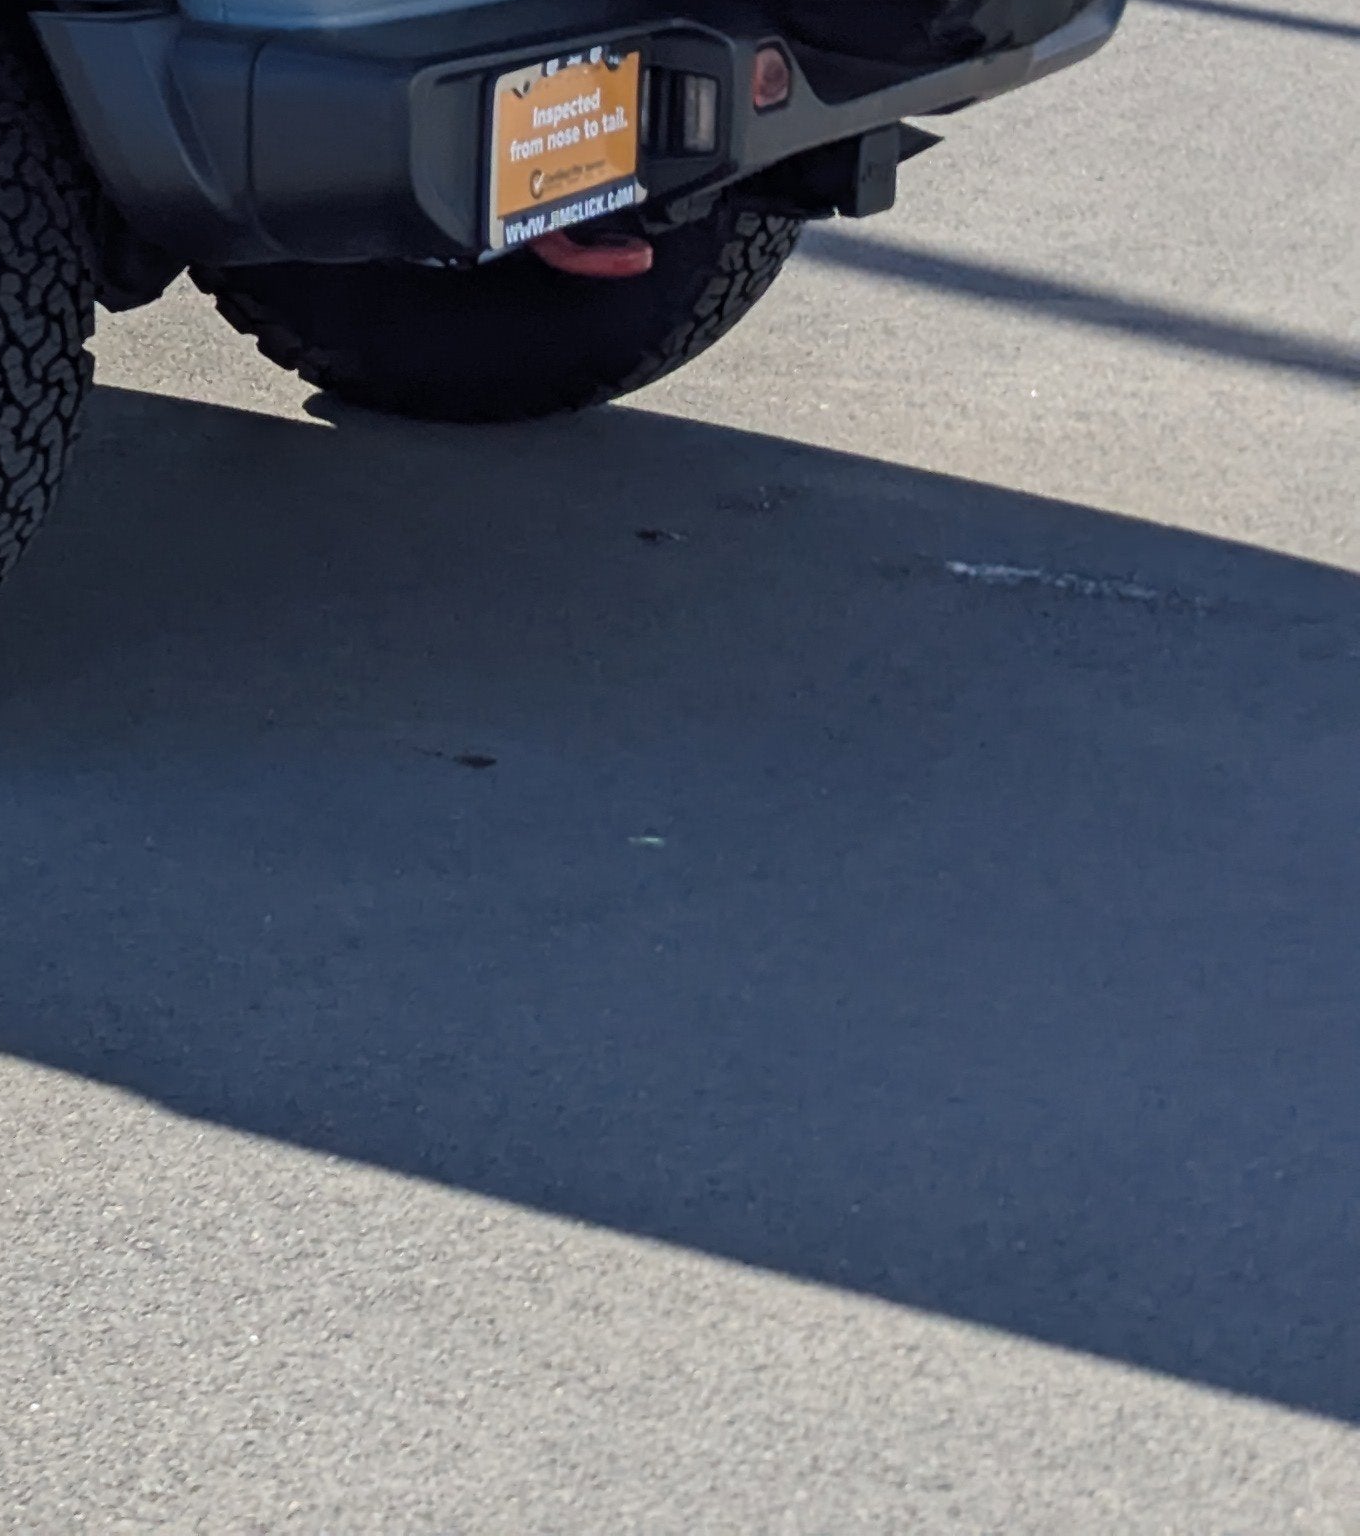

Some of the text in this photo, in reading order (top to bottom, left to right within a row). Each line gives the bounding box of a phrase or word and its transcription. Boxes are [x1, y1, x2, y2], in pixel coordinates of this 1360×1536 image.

[533, 87, 600, 128] Inspected
[510, 137, 543, 162] from
[547, 126, 580, 150] nose
[584, 119, 599, 139] to
